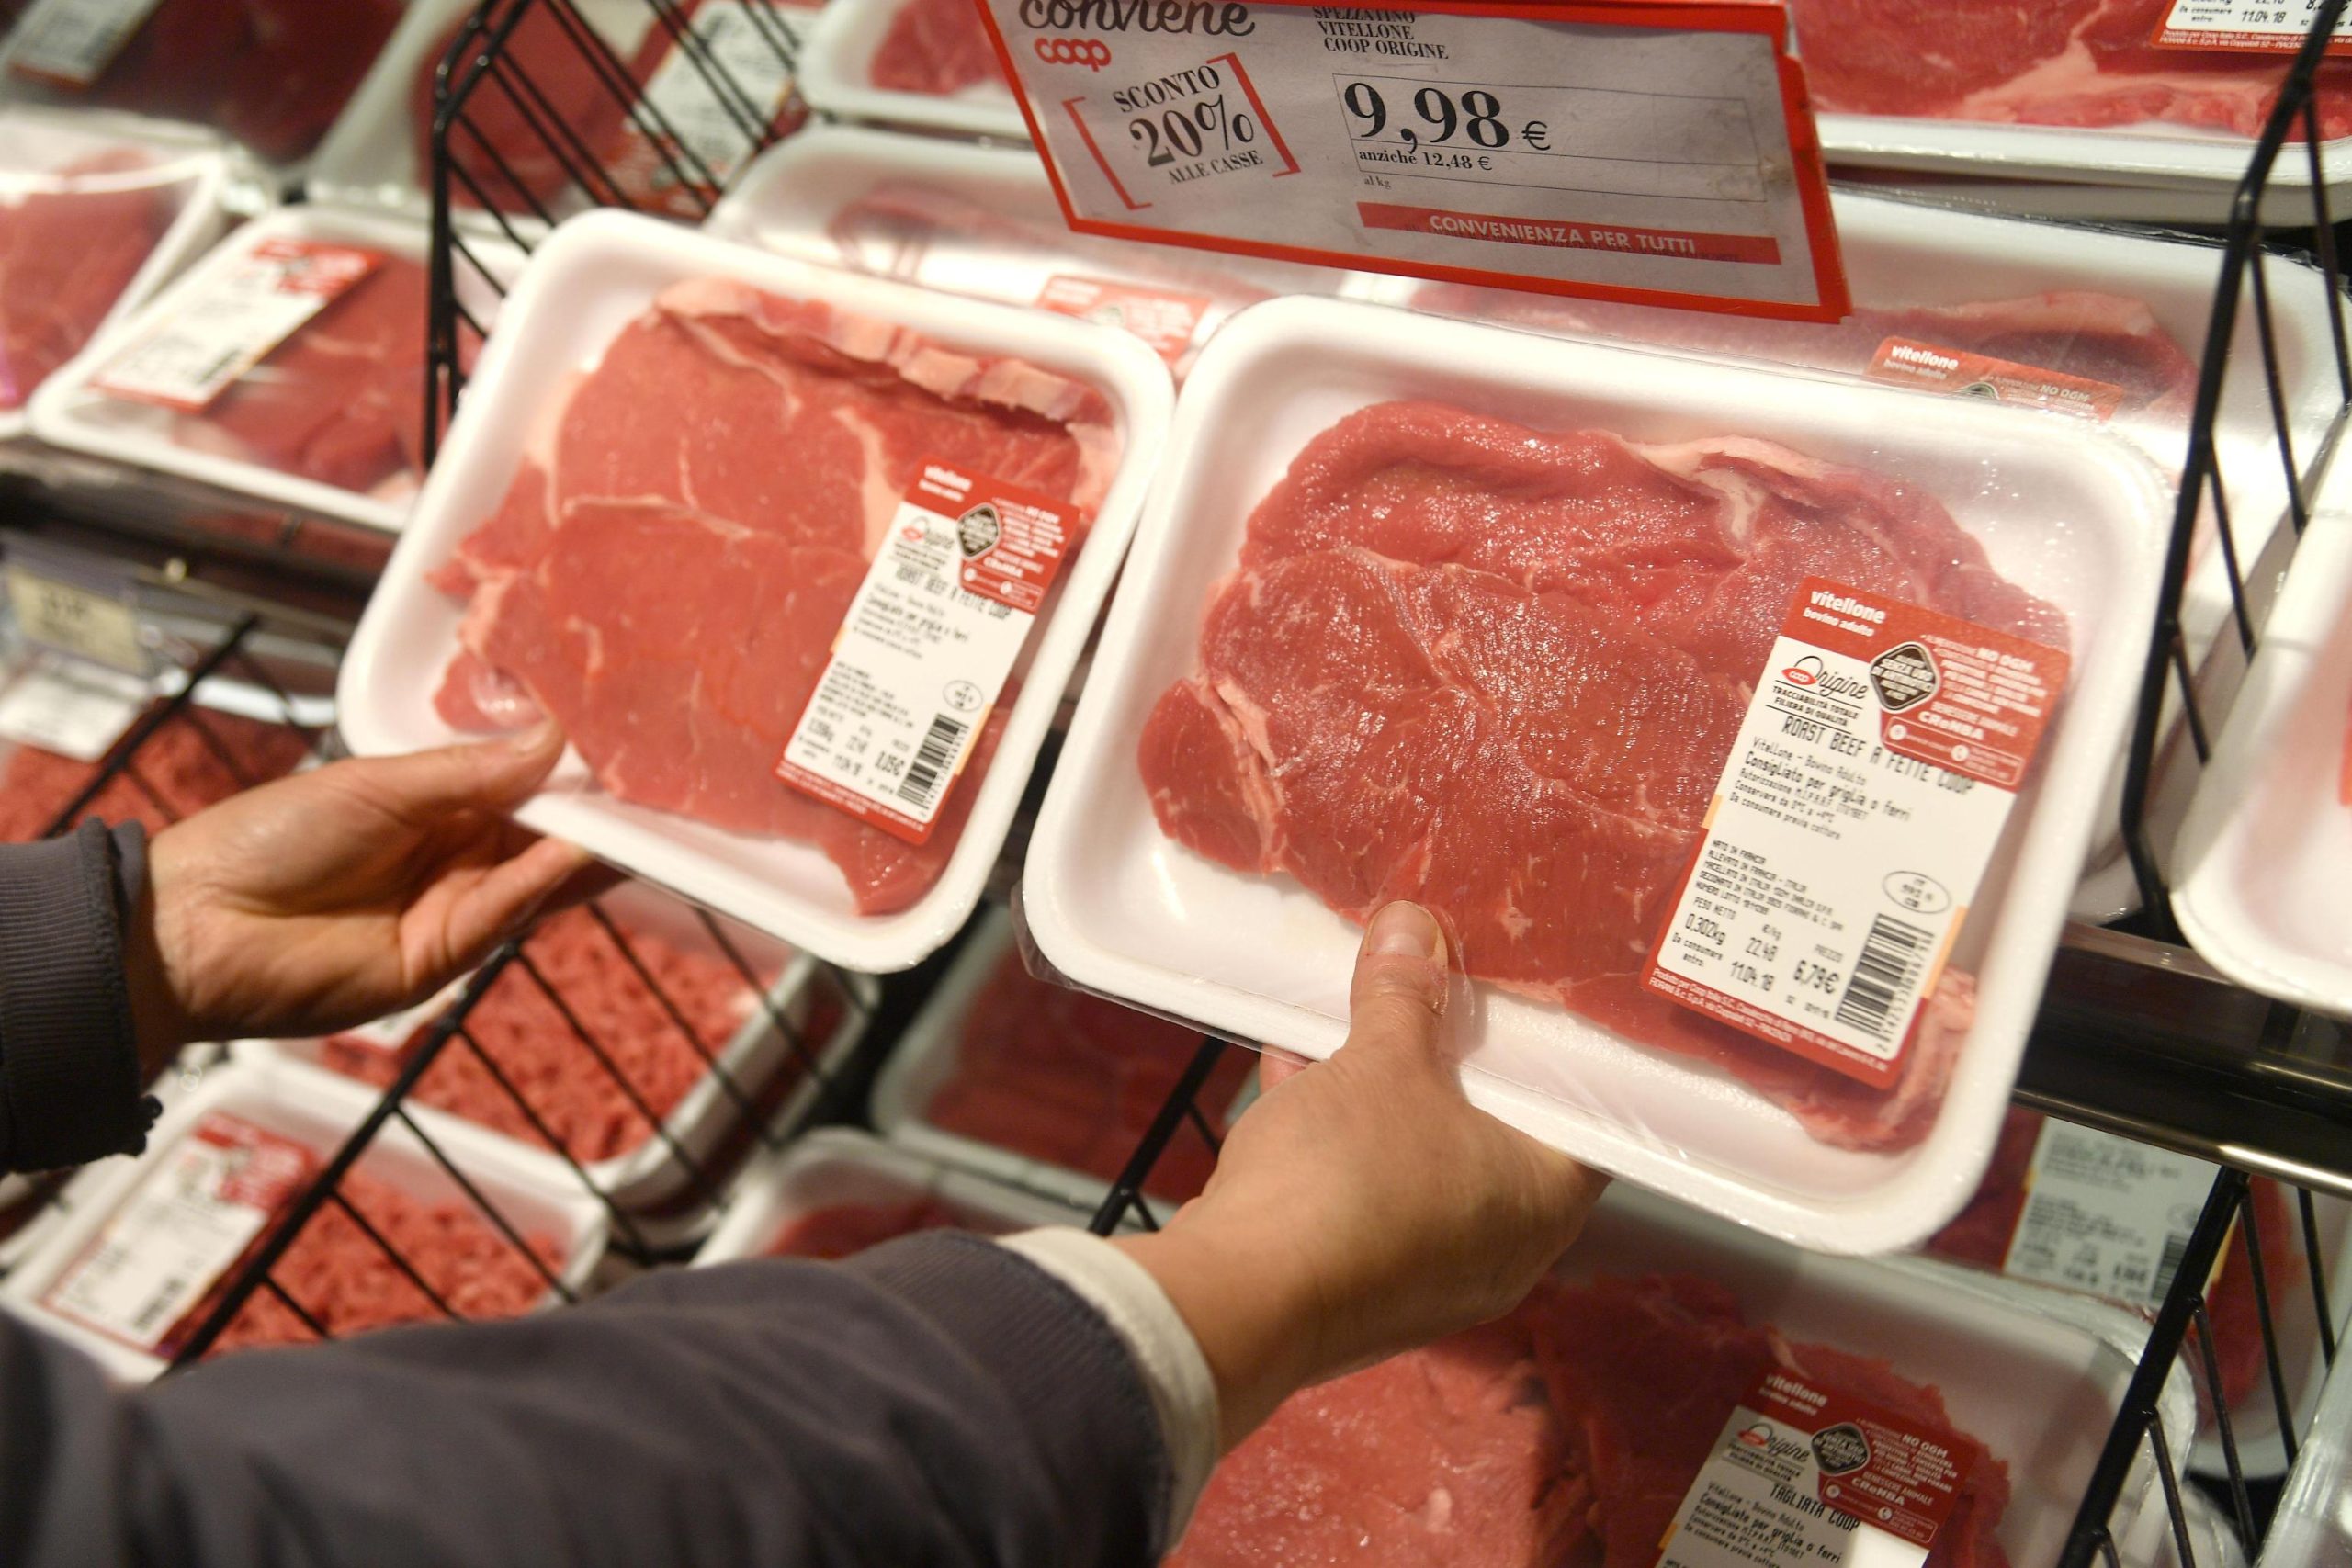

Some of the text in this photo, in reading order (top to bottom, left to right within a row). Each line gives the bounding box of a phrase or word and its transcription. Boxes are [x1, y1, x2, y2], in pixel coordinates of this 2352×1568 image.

[1317, 21, 1415, 39] VITELLONE
[1035, 38, 1112, 72] coop
[1324, 38, 1449, 60] COOP ORIGINE
[1113, 65, 1221, 113] SCONTO
[1129, 94, 1255, 168] 20%
[1344, 82, 1551, 154] 9,98 €
[1168, 150, 1264, 185] ALLE CASSE
[1422, 152, 1473, 171] 12,48
[1477, 156, 1493, 171] €
[1376, 175, 1392, 189] kg
[1429, 214, 1584, 244] CONVENIENZA
[1591, 230, 1629, 248] PER
[1635, 233, 1696, 254] TUTTI
[1891, 345, 1959, 371] vitellone
[1811, 589, 1885, 623] vitellone
[1804, 607, 1874, 636] bovino adulto
[1976, 647, 2033, 671] NO OGM
[1788, 671, 1808, 683] coop
[1773, 685, 1858, 718] TRACCIABILITÀ TOTALE
[1775, 697, 1803, 711] FILIERA
[1815, 710, 1848, 726] QUALITÀ
[1752, 738, 1792, 759] Vitellone
[1805, 756, 1834, 773] Bovino
[1837, 766, 1867, 784] Adulto
[1782, 716, 1825, 743] ROAST
[1830, 733, 1865, 757] BEEF
[1869, 745, 1883, 764] A
[1886, 752, 1931, 780] FETTE
[1736, 780, 1776, 801] Conservare
[1779, 795, 1789, 807] da
[1745, 752, 1912, 820] Consigliato per griglia o ferri
[1729, 791, 1840, 840] Da consumare previa cottura
[1693, 897, 1736, 919] PESO NETTO
[1672, 931, 1721, 960] Da consumare
[1728, 962, 1774, 991] 11.04.18
[1793, 961, 1839, 994] 6,79€
[1764, 1374, 1827, 1405] vitellone
[1901, 1434, 1948, 1457] NO OGM
[1850, 1478, 1905, 1505] CReNBA
[1900, 1487, 1933, 1506] ANIMALE
[1769, 1485, 1825, 1517] TAGLIATA
[1827, 1509, 1861, 1532] COOP
[1700, 1493, 1750, 1521] Consigliato
[1750, 1517, 1770, 1532] per
[1771, 1526, 1804, 1547] griglia
[1816, 1544, 1842, 1562] ferri
